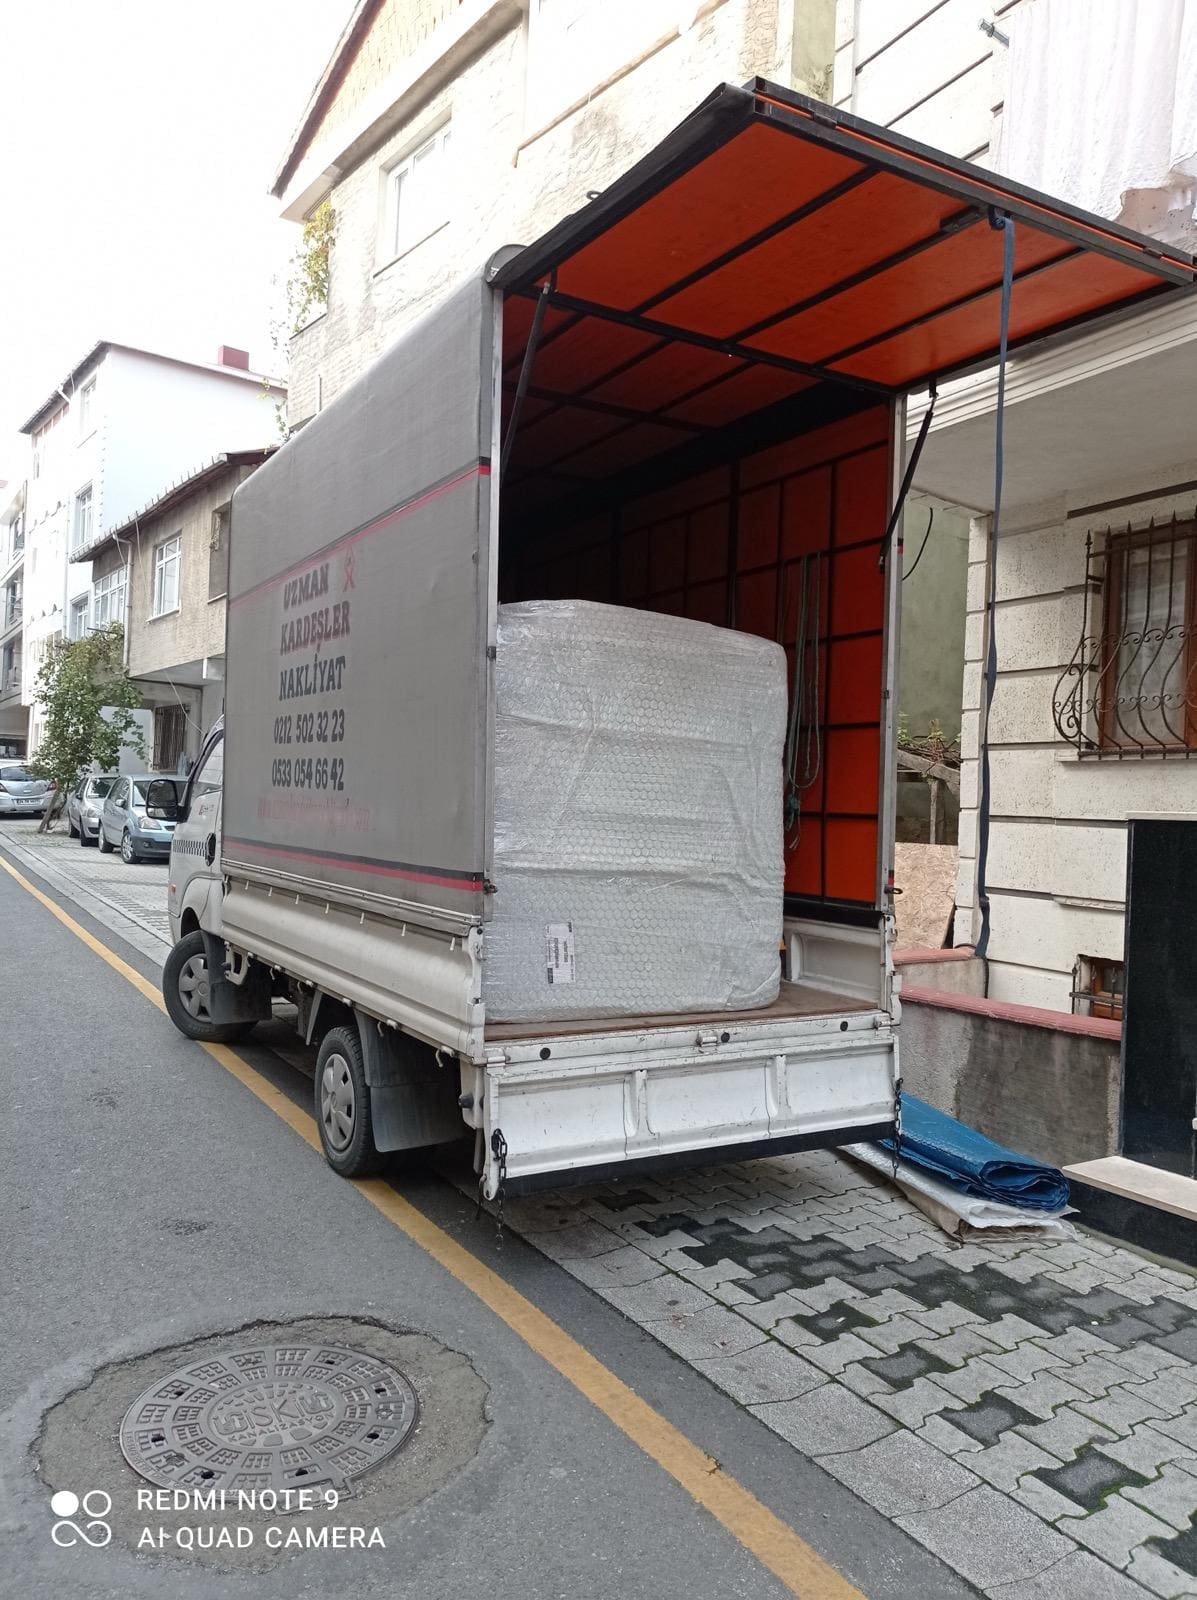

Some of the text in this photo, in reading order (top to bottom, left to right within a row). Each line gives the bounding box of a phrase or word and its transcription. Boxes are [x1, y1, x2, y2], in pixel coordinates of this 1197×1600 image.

[283, 563, 330, 611] UZMAN
[280, 600, 350, 656] KARDEŞLER
[278, 652, 346, 701] NAKLİYAT
[274, 708, 345, 744] 0212 502 32 23
[272, 757, 345, 791] 0533 054 66 42
